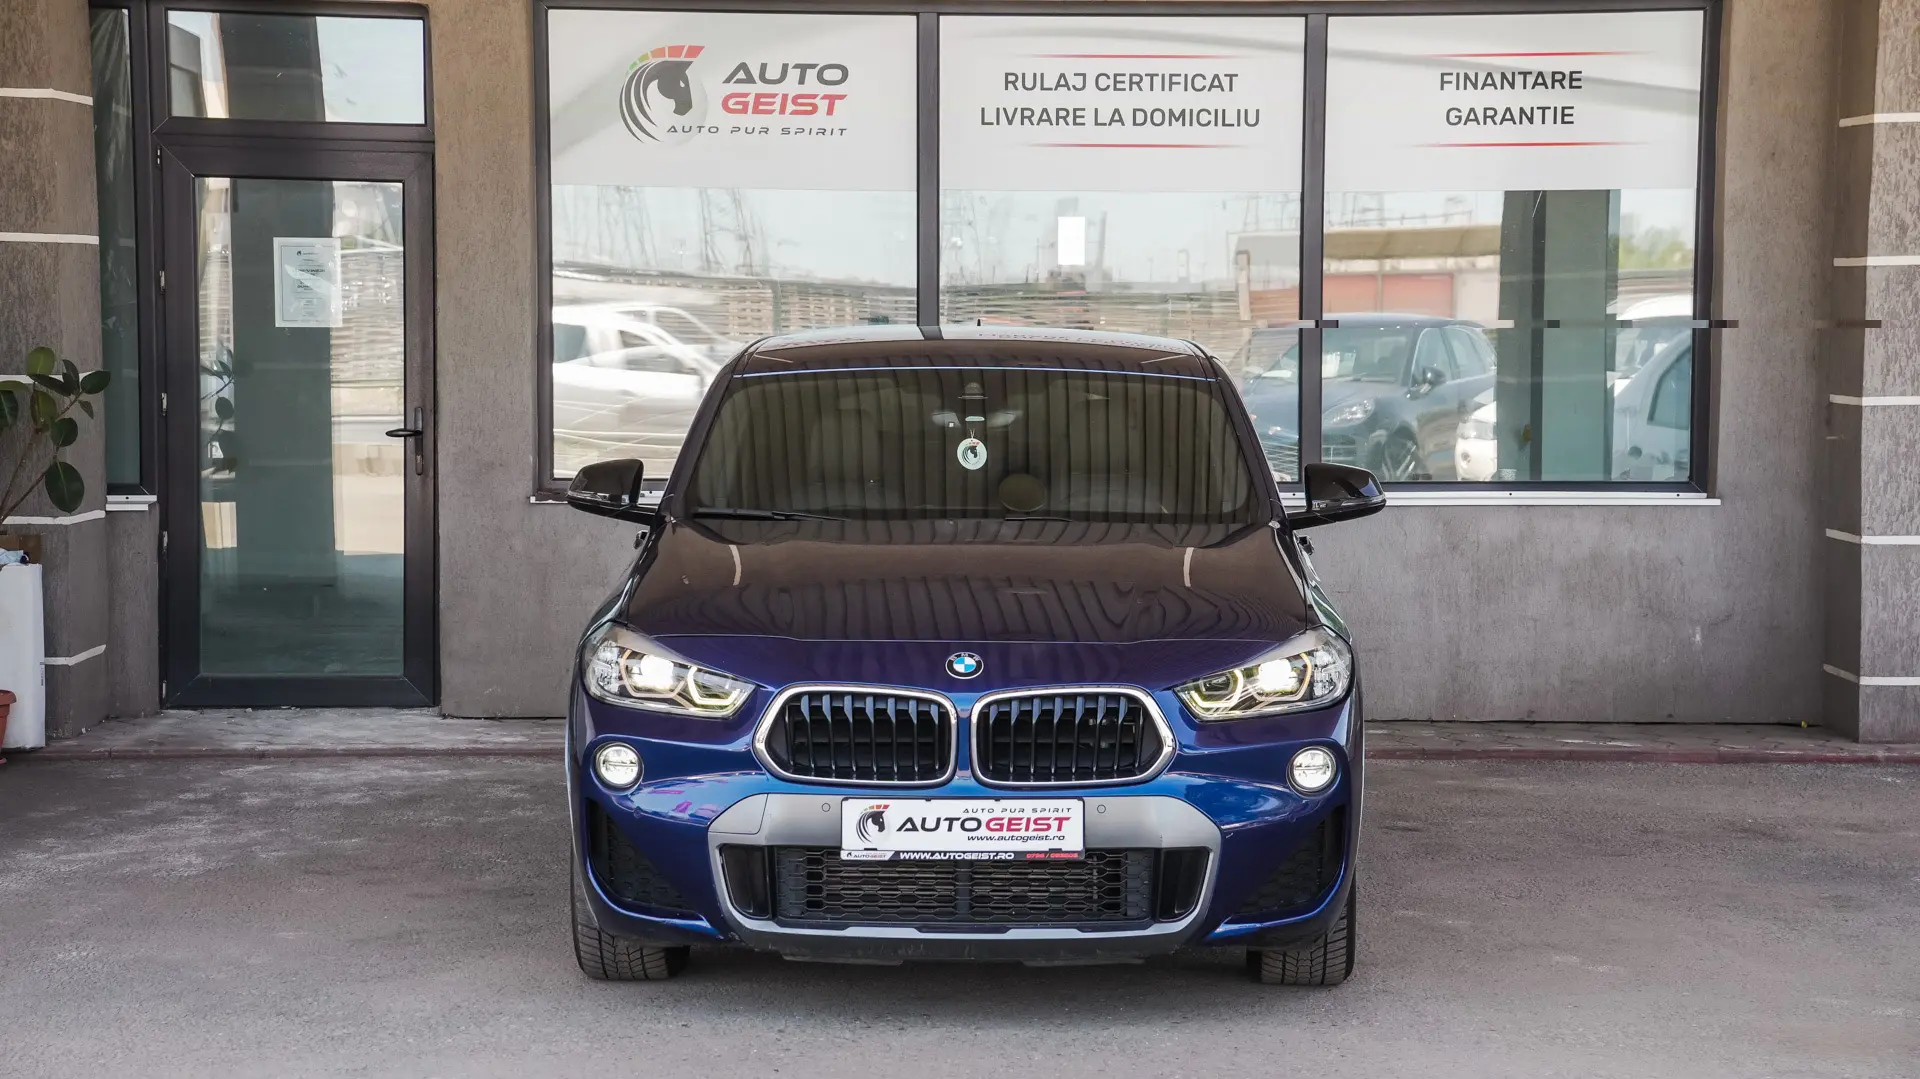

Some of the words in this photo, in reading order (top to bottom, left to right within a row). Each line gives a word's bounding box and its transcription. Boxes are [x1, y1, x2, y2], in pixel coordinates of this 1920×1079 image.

[722, 61, 849, 86] AUTO
[1003, 72, 1087, 92] RULAJ
[1094, 73, 1239, 93] CERTIFICAT
[1439, 70, 1583, 91] FINANTARE
[721, 92, 848, 117] GEIST
[980, 107, 1086, 127] LIVRARE
[1093, 107, 1126, 127] LA
[1131, 108, 1261, 128] DOMICILIU
[1445, 105, 1575, 126] GARANTIE
[666, 125, 720, 135] AUTO
[730, 126, 770, 136] PUR
[780, 127, 848, 137] SPIRIT
[896, 816, 1072, 832] AUTOGEIST
[967, 833, 1066, 843] www.autogeist.ro
[899, 851, 1015, 860] WWW.AUTOGEIST.RO
